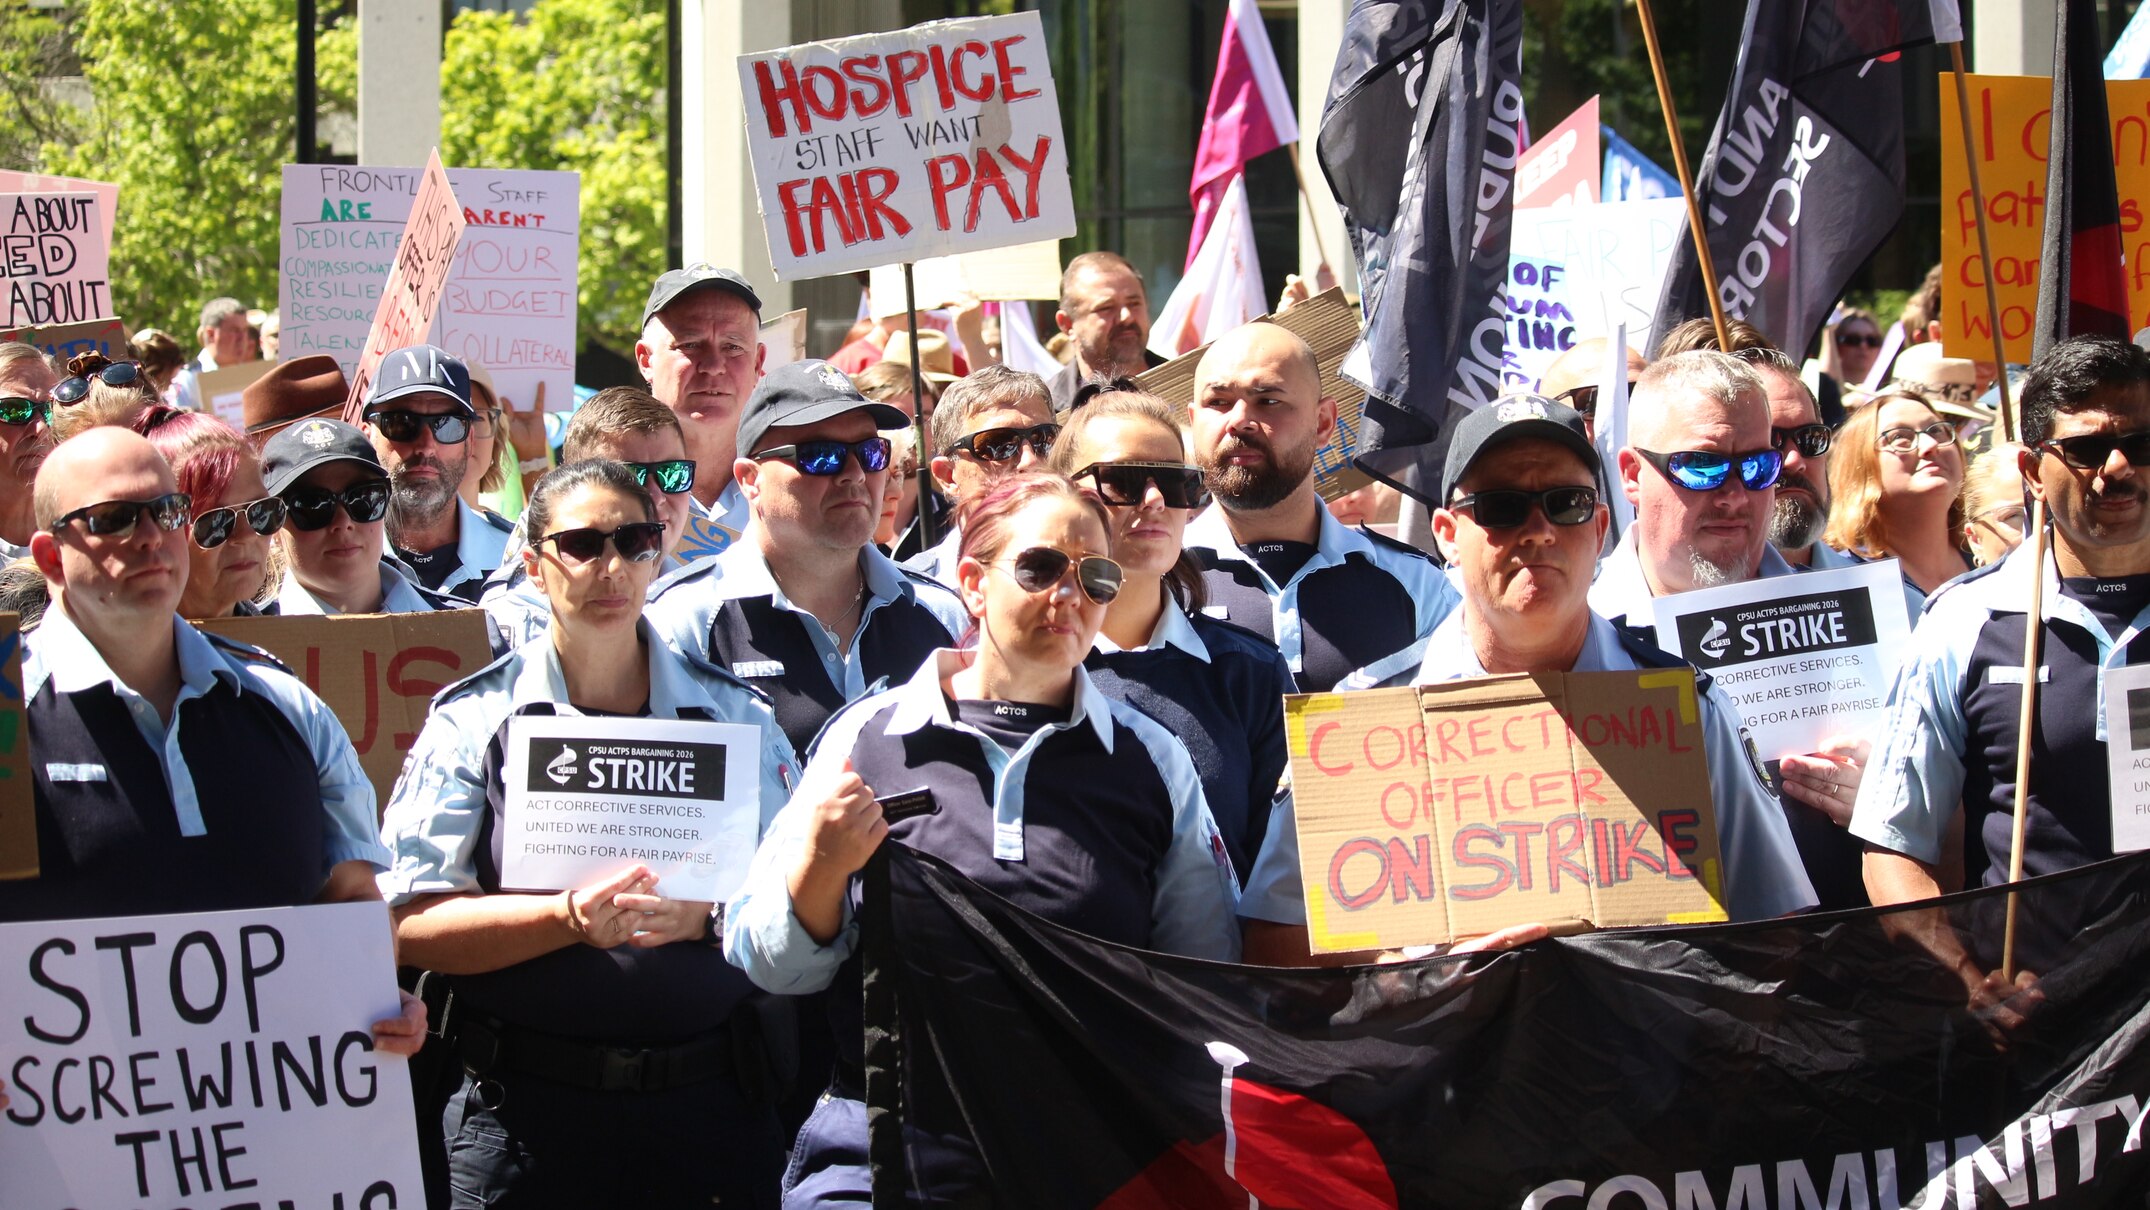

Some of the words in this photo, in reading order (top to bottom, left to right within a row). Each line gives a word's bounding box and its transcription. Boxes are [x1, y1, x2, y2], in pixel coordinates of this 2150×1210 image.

[752, 35, 1042, 138] HOSPICE
[795, 127, 884, 170] STAFF
[904, 114, 984, 149] WANT
[321, 198, 371, 222] ARE
[489, 182, 548, 204] STAFF
[777, 167, 913, 257] FAIR
[924, 134, 1051, 233] PAY
[11, 196, 93, 233] ABOUT
[415, 169, 447, 262] THIS
[464, 207, 545, 228] AREN'T
[0, 233, 77, 278] ED
[296, 227, 402, 250] DEDICATE
[1537, 219, 1626, 279] FAIR
[285, 257, 391, 278] COMPASSIONAT
[457, 240, 559, 279] YOUR
[1513, 262, 1565, 292] OF
[399, 232, 424, 307] OFFER
[422, 284, 436, 324] IS
[9, 280, 105, 325] ABOUT
[444, 283, 571, 313] BUDGET
[1600, 286, 1652, 335] IS
[444, 329, 574, 367] COLLATERAL
[1258, 544, 1284, 553] ACTCS
[2096, 583, 2127, 593] ACTCS
[1736, 612, 1756, 622] CPSU
[1756, 608, 1778, 619] ACTPS
[1779, 602, 1821, 616] BARGAINING
[1822, 600, 1839, 610] 2026
[1740, 611, 1847, 657] STRIKE
[1715, 662, 1797, 686] CORRECTIVE
[1800, 654, 1863, 673] SERVICES.
[1742, 692, 1764, 706] WE
[1767, 687, 1791, 702] ARE
[1795, 677, 1865, 696] STRONGER.
[994, 704, 1027, 716] ACTCS
[1761, 711, 1788, 726] FOR
[1790, 709, 1800, 721] A
[1802, 704, 1829, 719] FAIR
[1832, 697, 1884, 714] PAYRISE.
[588, 746, 607, 755] CPSU
[607, 747, 630, 756] ACTPS
[631, 747, 674, 758] BARGAINING
[676, 749, 694, 759] 2026
[1310, 706, 1692, 776] CORRECTIONAL
[587, 758, 696, 793] STRIKE
[2133, 758, 2150, 770] AC
[526, 800, 550, 811] ACT
[554, 800, 636, 815] CORRECTIVE
[640, 804, 706, 819] SERVICES.
[1380, 768, 1608, 829] OFFICER
[525, 822, 574, 834] UNITED
[577, 823, 597, 835] WE
[600, 823, 626, 836] ARE
[629, 825, 703, 841] STRONGER.
[524, 843, 587, 856] FIGHTING
[590, 845, 617, 857] FOR
[619, 847, 629, 858] A
[631, 848, 659, 860] FAIR
[662, 851, 716, 865] PAYRISE.
[1328, 834, 1435, 911] ON
[1449, 809, 1699, 900] STRIKE
[24, 924, 285, 1045] STOP
[6, 1031, 377, 1126] SCREWING
[115, 1121, 257, 1197] THE
